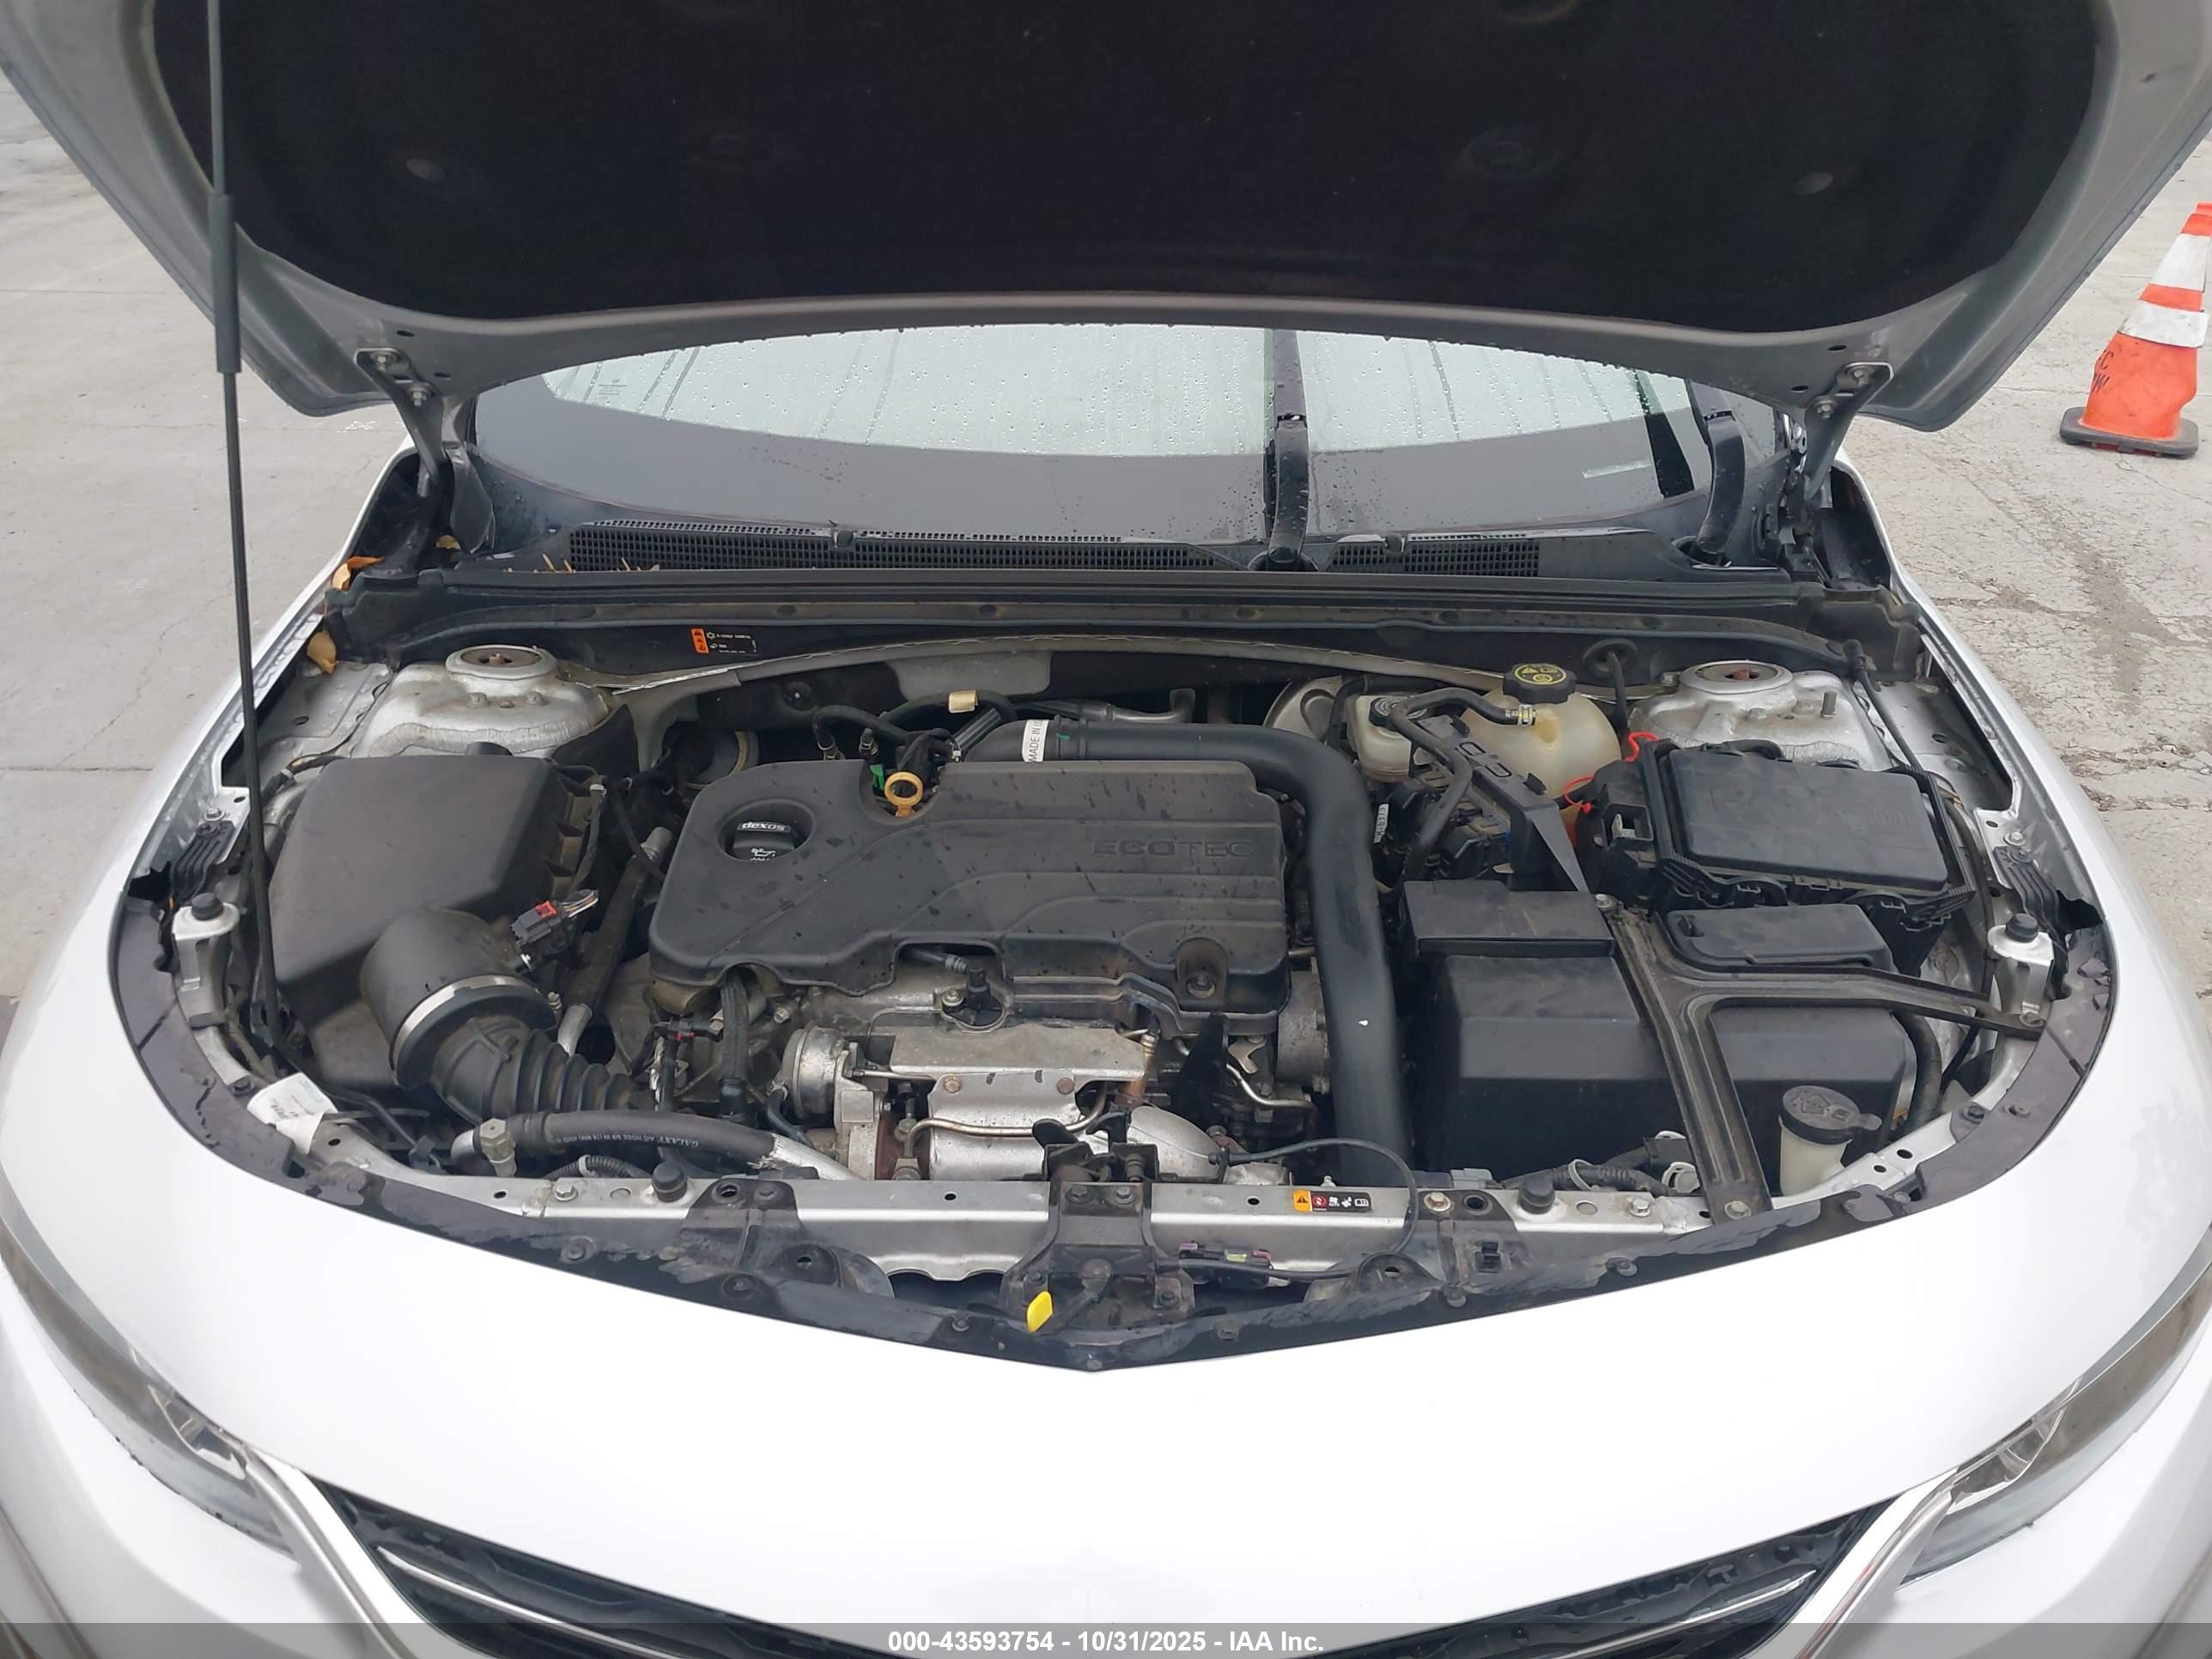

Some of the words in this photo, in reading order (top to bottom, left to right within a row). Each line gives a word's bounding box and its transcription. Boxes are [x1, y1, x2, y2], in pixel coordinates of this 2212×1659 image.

[1030, 726, 1042, 735] IN
[1028, 735, 1040, 762] MADE
[741, 821, 785, 831] dexos
[1093, 839, 1253, 857] ECOTEC
[659, 1136, 700, 1148] GALAXY
